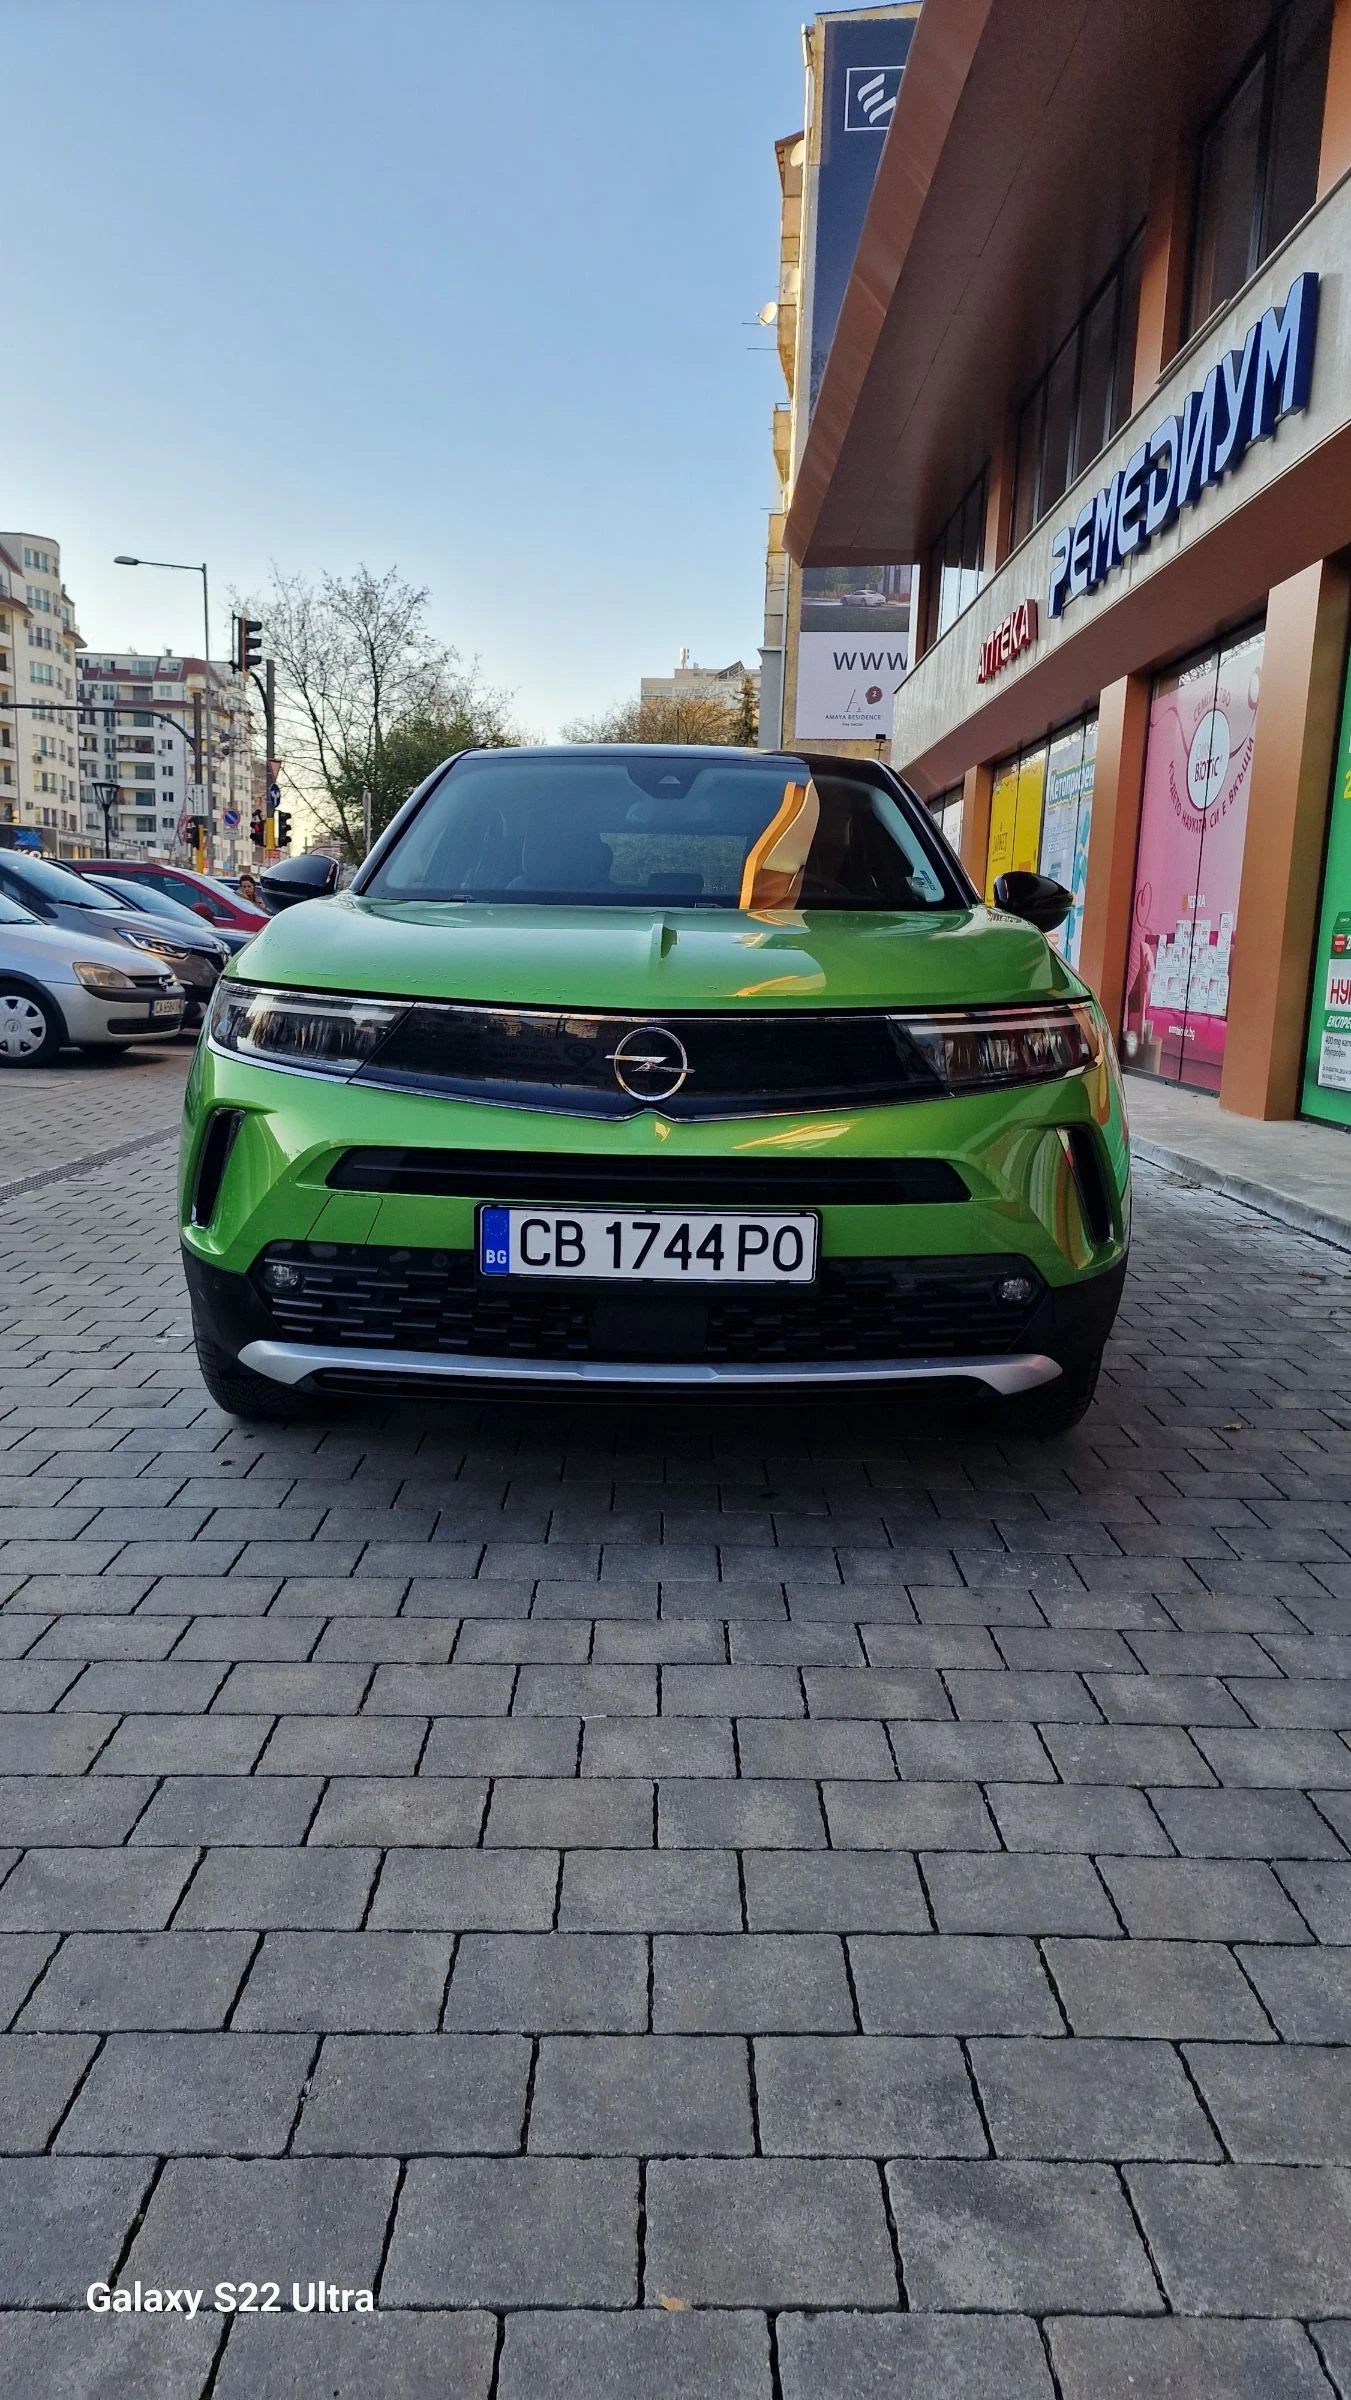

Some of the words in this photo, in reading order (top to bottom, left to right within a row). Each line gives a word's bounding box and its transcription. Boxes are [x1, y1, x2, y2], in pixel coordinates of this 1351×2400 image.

[976, 599, 1037, 684] АПТЕКА
[1210, 808, 1219, 828] СИ
[485, 1249, 507, 1265] BG
[520, 1218, 586, 1267] CB
[605, 1221, 725, 1271] 1744
